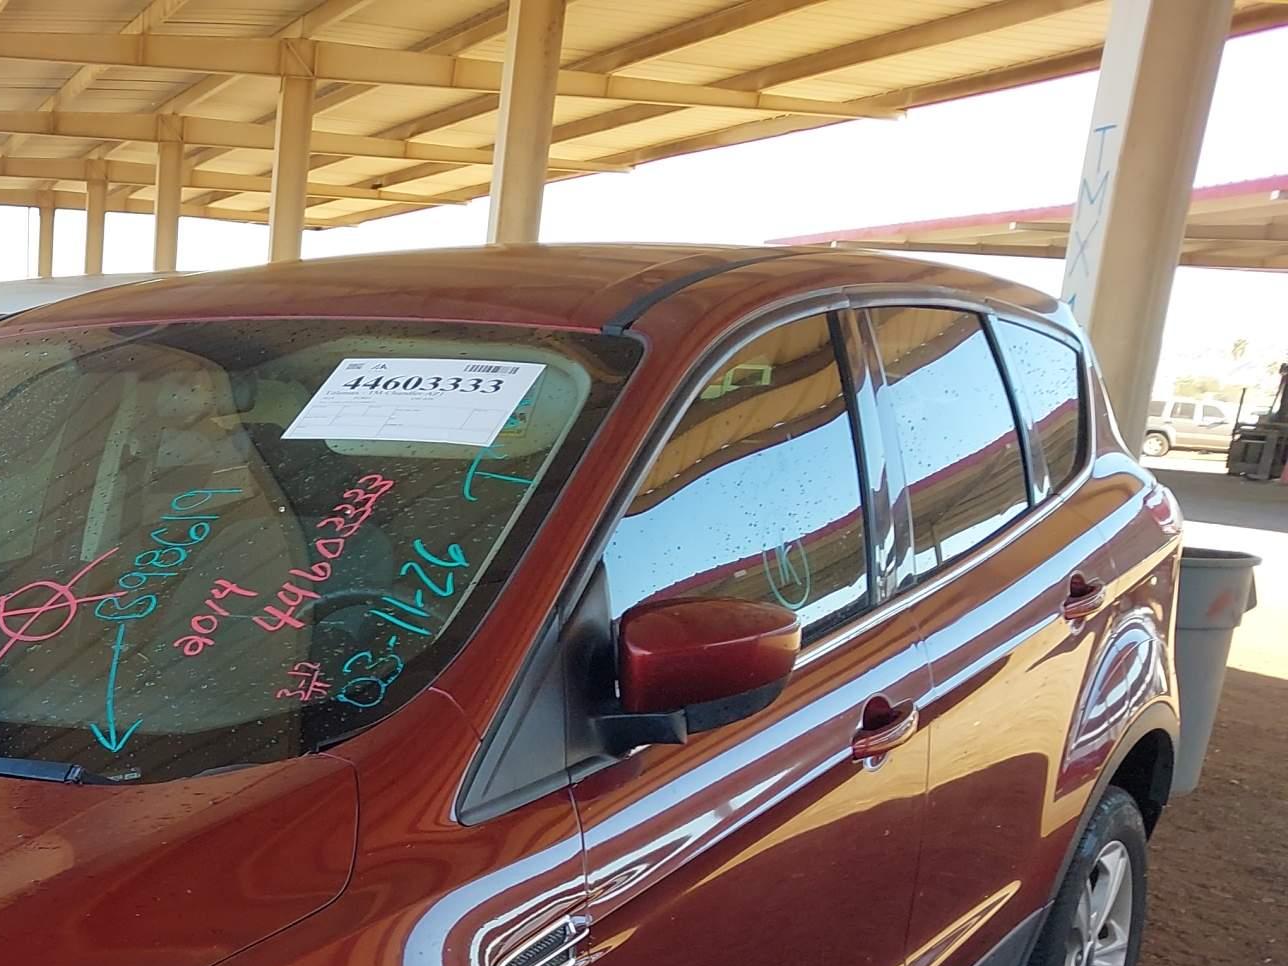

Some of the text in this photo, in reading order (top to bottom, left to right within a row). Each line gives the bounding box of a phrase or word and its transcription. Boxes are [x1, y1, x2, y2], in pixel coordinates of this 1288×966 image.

[343, 375, 505, 394] 44603333
[251, 474, 394, 632] 44603333
[173, 578, 259, 656] 2014
[336, 538, 470, 708] 03-11-26
